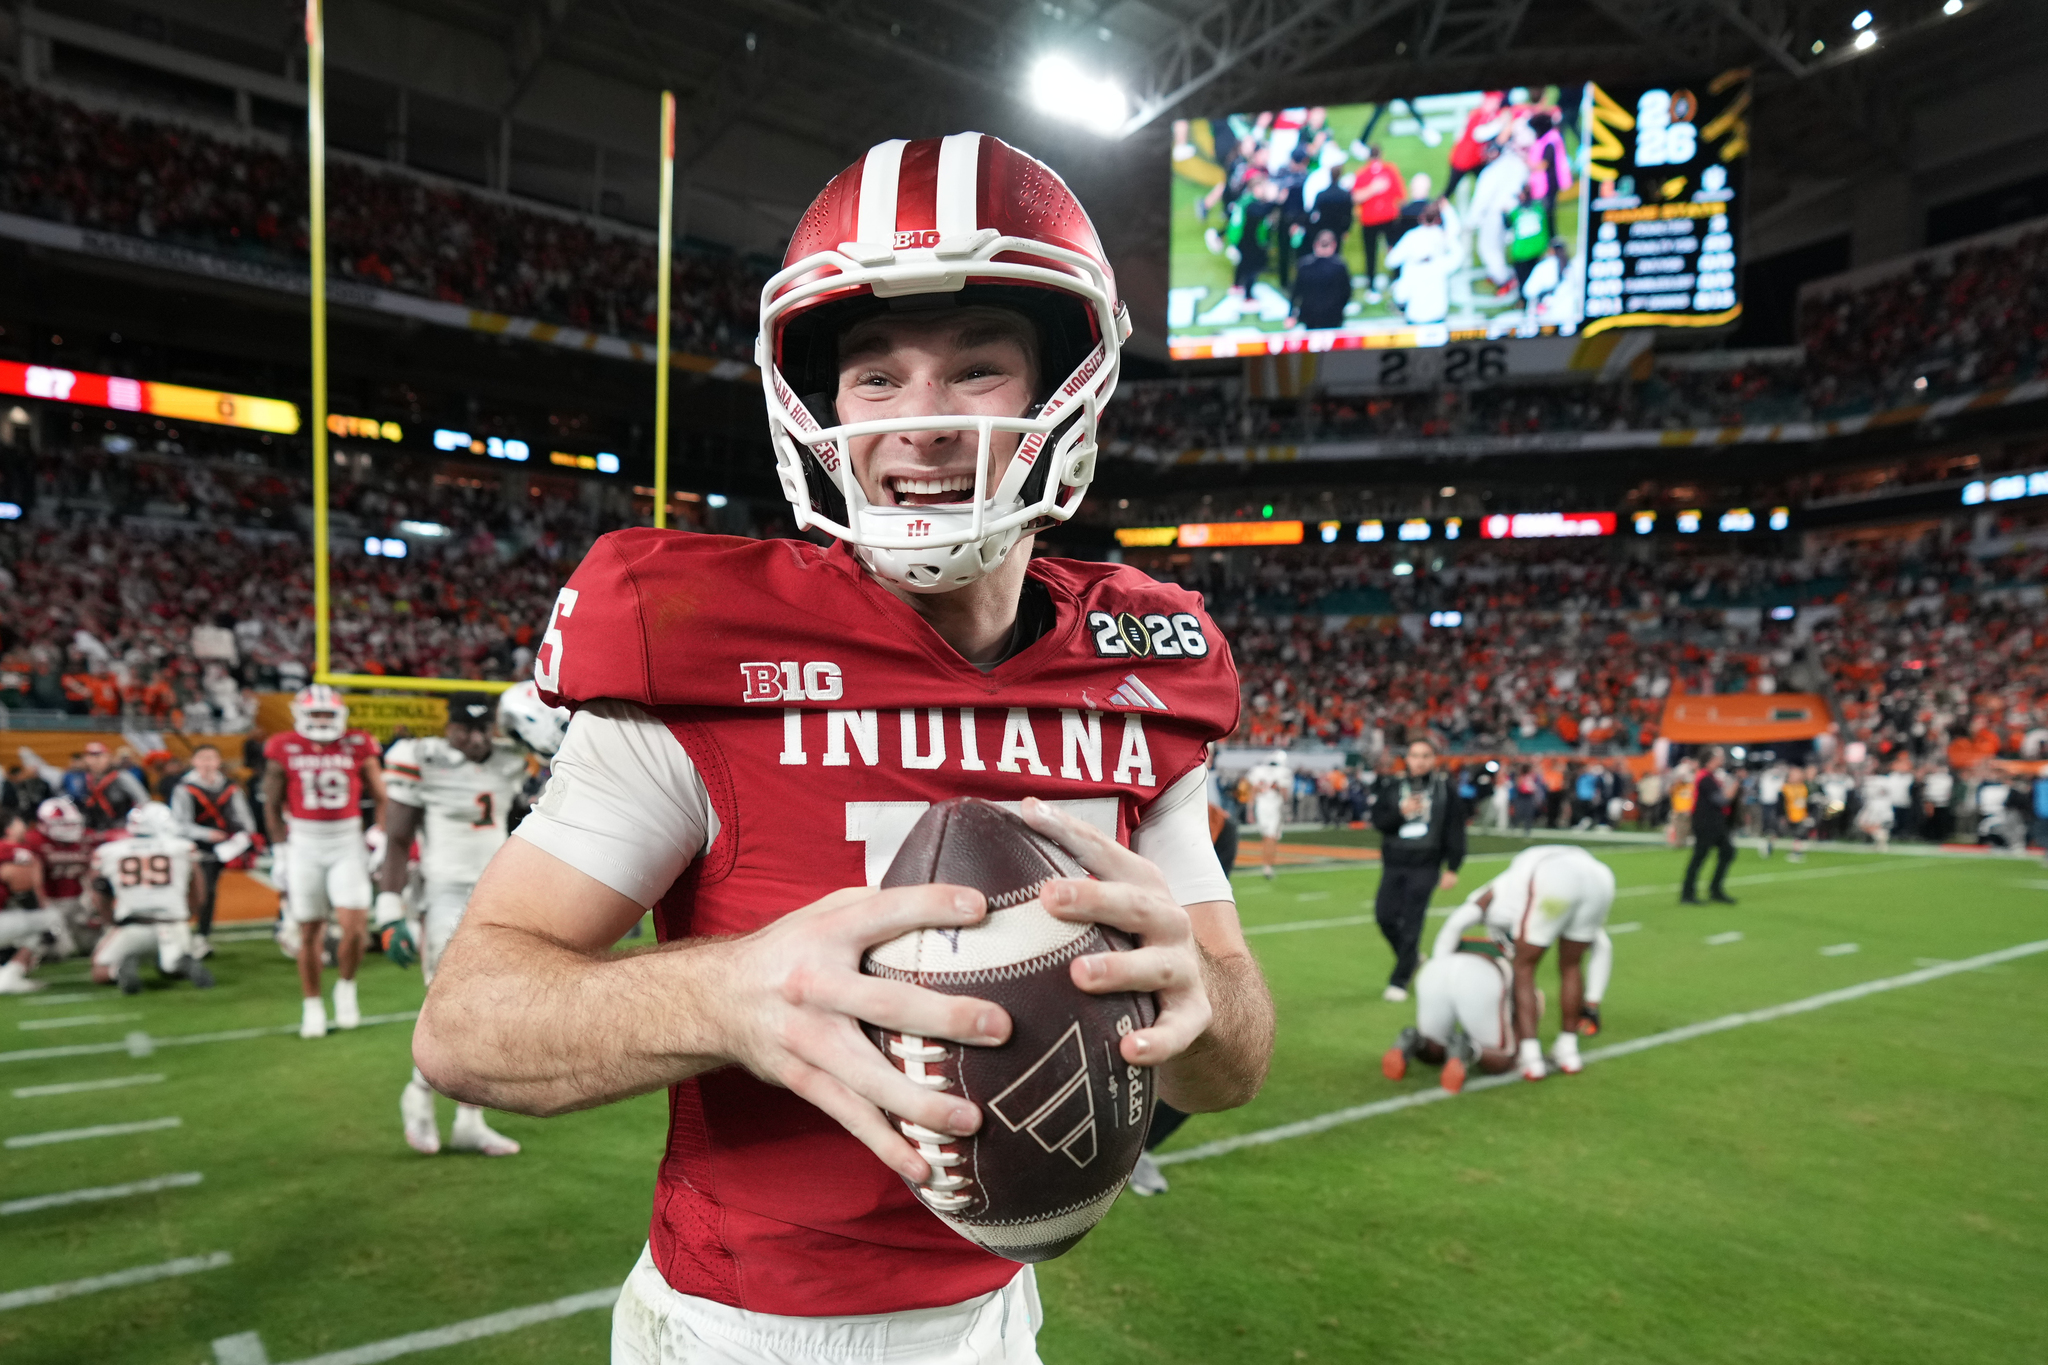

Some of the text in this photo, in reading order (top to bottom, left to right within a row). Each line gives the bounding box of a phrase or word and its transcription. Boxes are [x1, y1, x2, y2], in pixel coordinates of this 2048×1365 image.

[1634, 122, 1698, 167] 26
[779, 707, 1156, 786] INDIANA
[298, 770, 351, 811] 19
[473, 792, 496, 829] 1
[118, 854, 172, 888] 99
